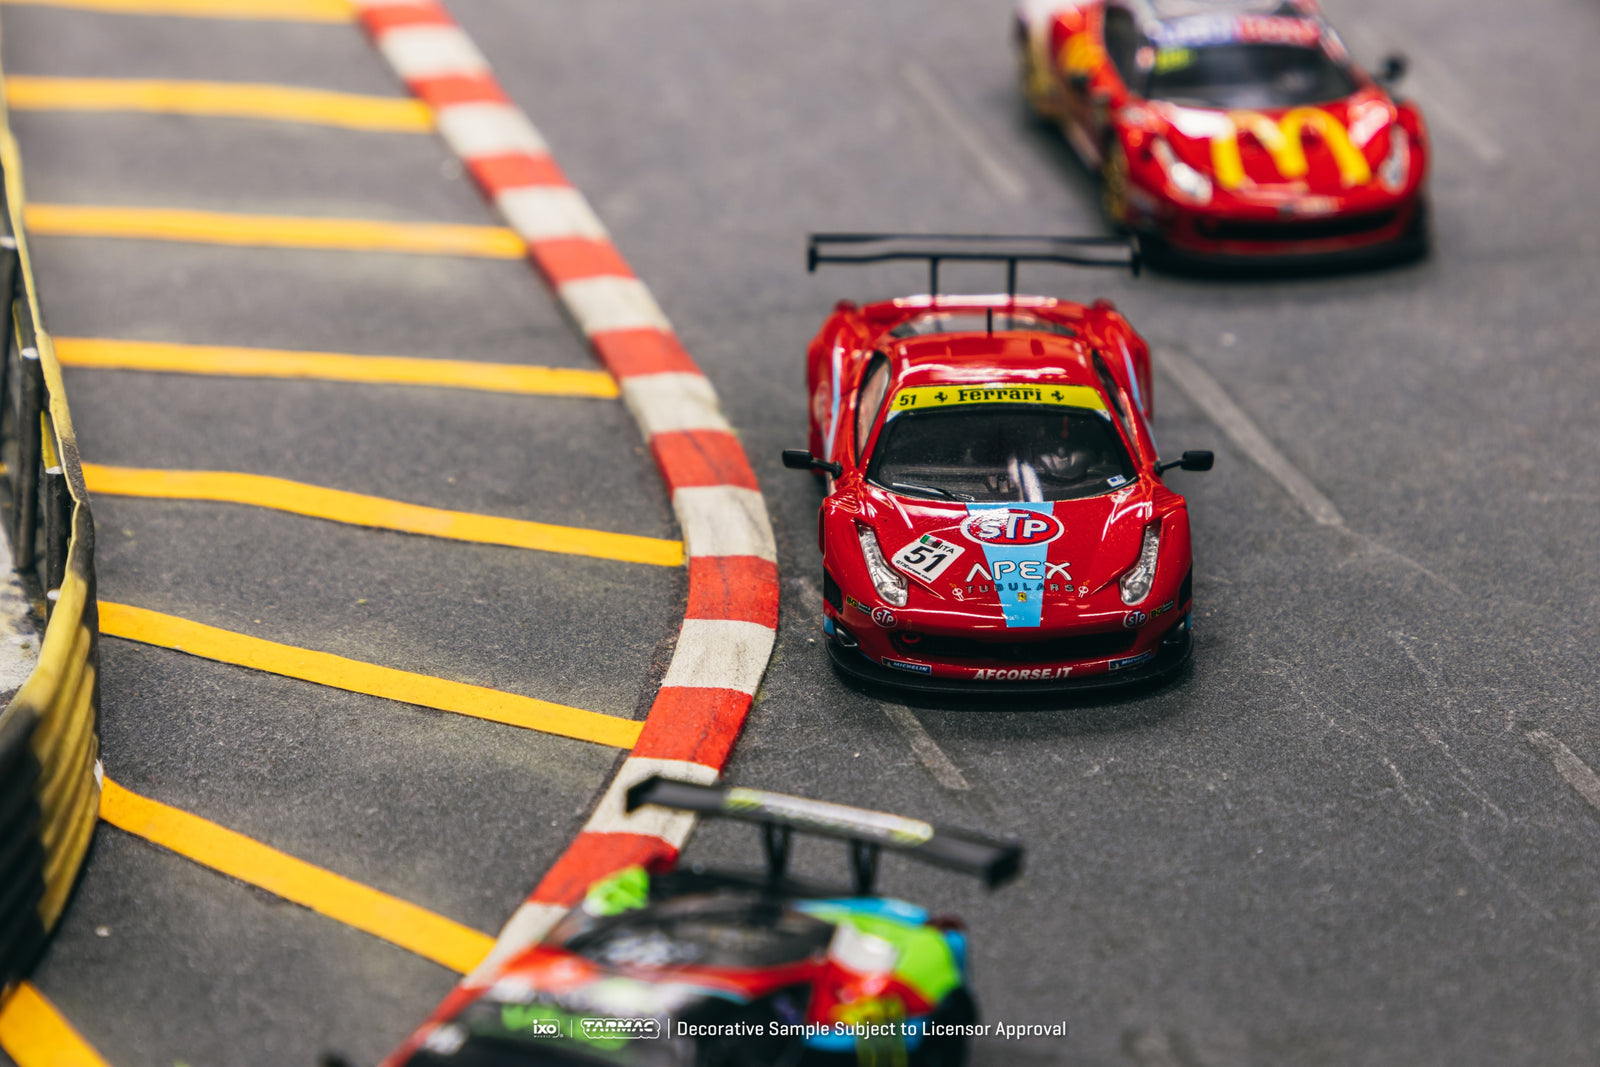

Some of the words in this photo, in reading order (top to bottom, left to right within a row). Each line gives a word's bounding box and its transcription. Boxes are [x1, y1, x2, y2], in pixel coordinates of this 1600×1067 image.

[899, 394, 917, 406] 51
[957, 388, 1042, 402] Ferrari
[978, 512, 1049, 540] STP
[938, 544, 954, 554] ITA
[903, 545, 948, 573] 51
[965, 560, 1073, 583] APEX
[966, 582, 1074, 593] TUBULARS
[875, 609, 894, 624] STP
[1128, 610, 1146, 626] STP
[893, 662, 928, 671] MICHELIN
[973, 666, 1073, 680] AFCORSE.IT
